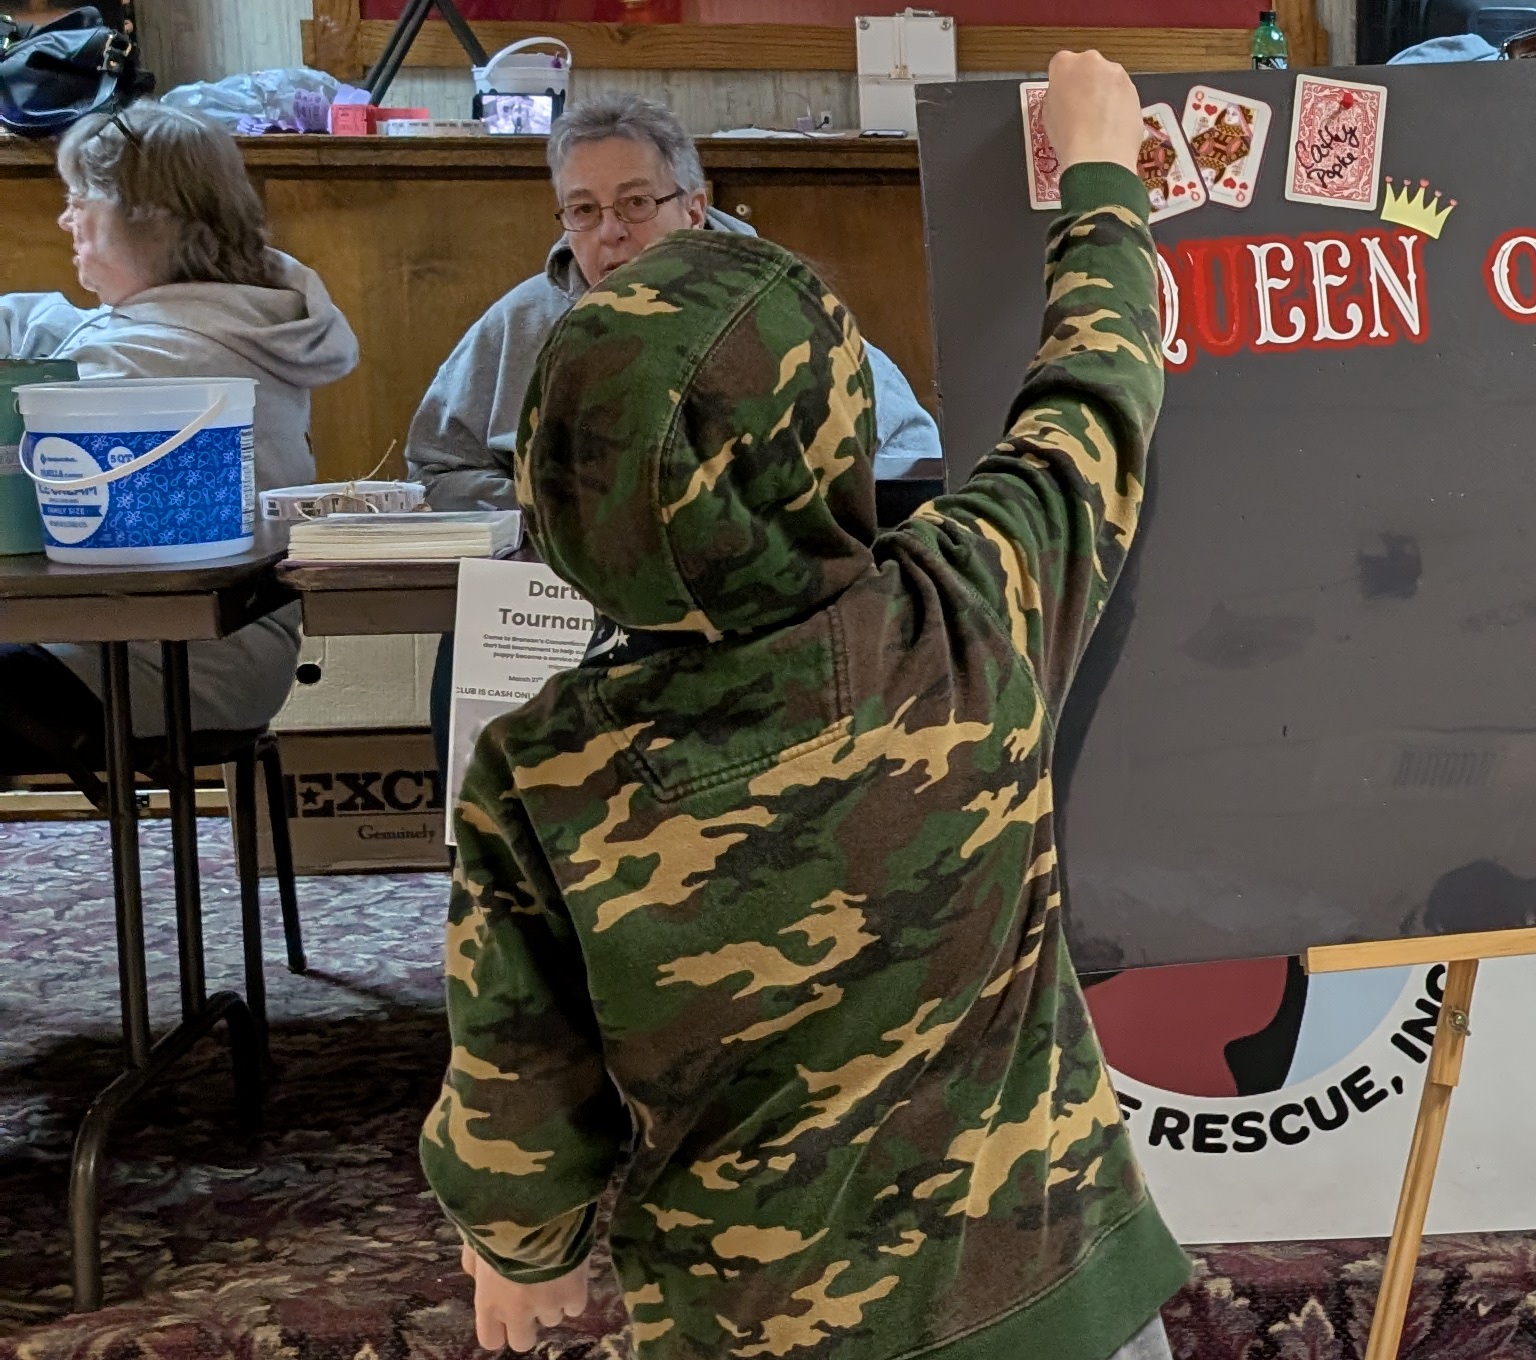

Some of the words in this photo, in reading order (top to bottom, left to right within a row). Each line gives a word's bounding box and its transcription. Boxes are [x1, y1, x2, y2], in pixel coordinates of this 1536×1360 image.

[478, 688, 486, 696] IS
[487, 689, 513, 698] CASH
[357, 824, 436, 843] Genuinely
[1148, 1064, 1405, 1155] RESCUE,
